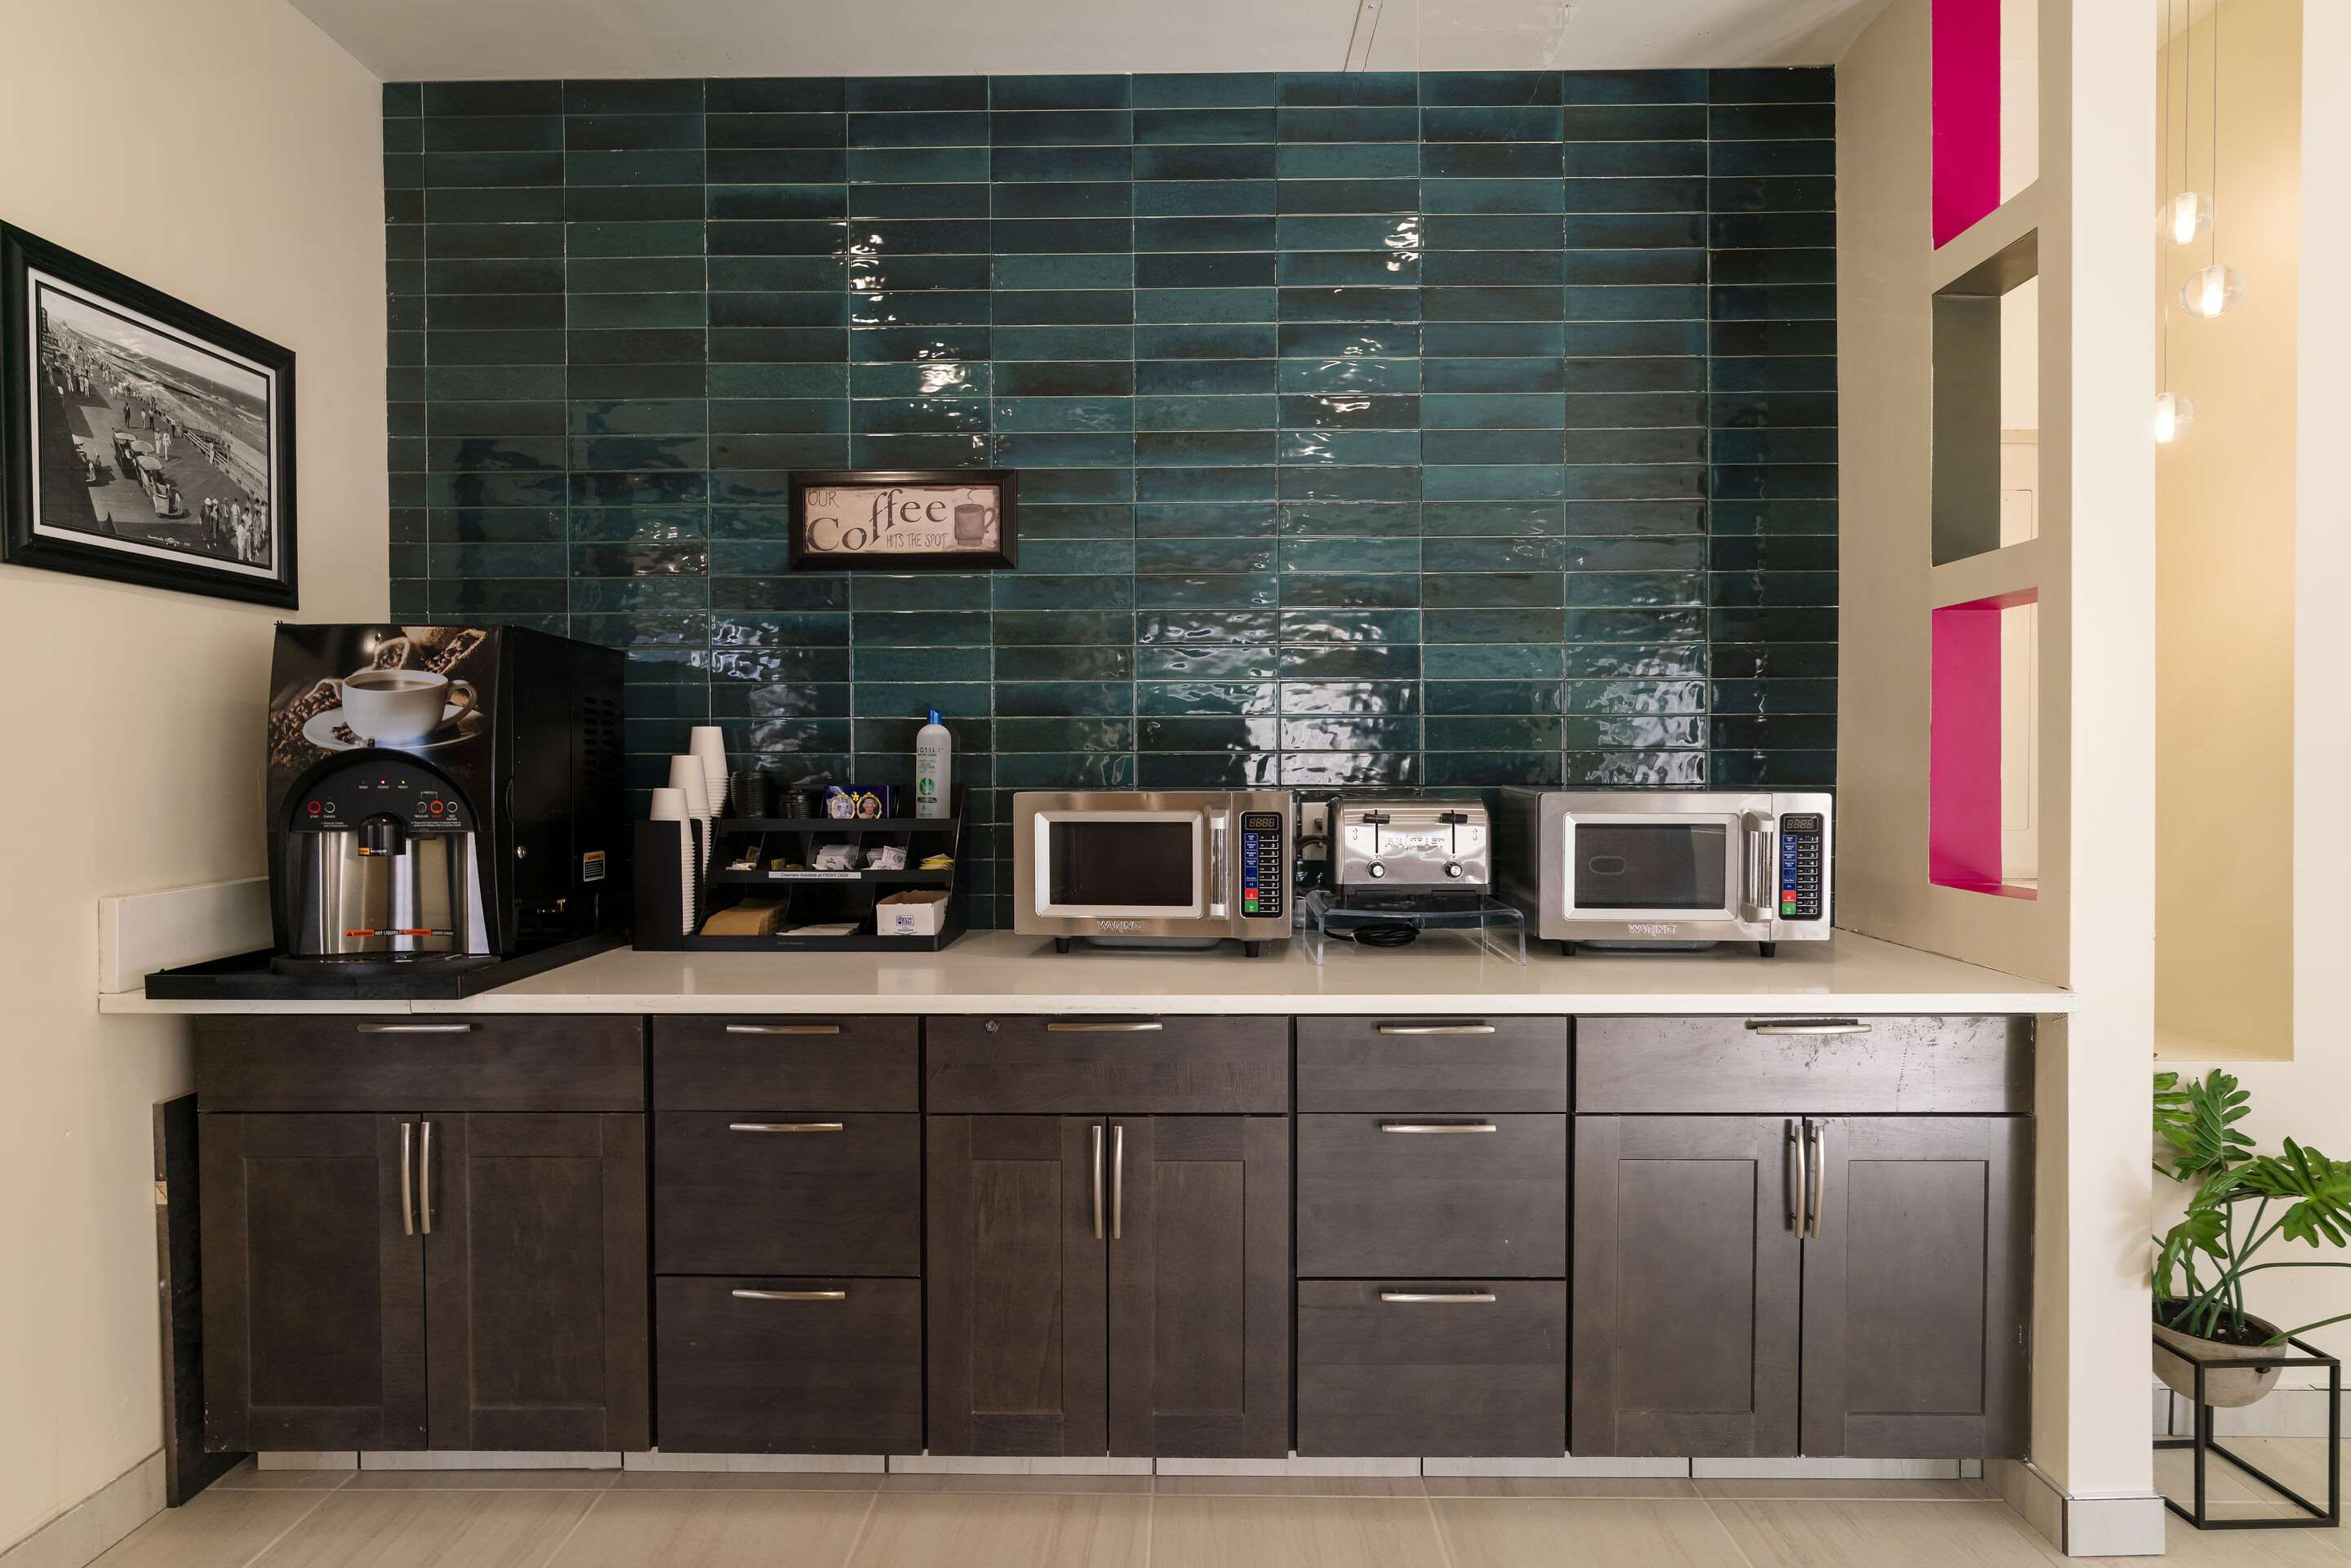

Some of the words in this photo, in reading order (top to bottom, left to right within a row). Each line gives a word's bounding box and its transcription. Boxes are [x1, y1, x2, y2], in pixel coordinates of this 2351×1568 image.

[807, 491, 840, 509] OUR
[807, 488, 947, 551] Coffee
[906, 531, 922, 549] THE
[924, 531, 949, 549] SPOT
[1627, 924, 1675, 937] WARING
